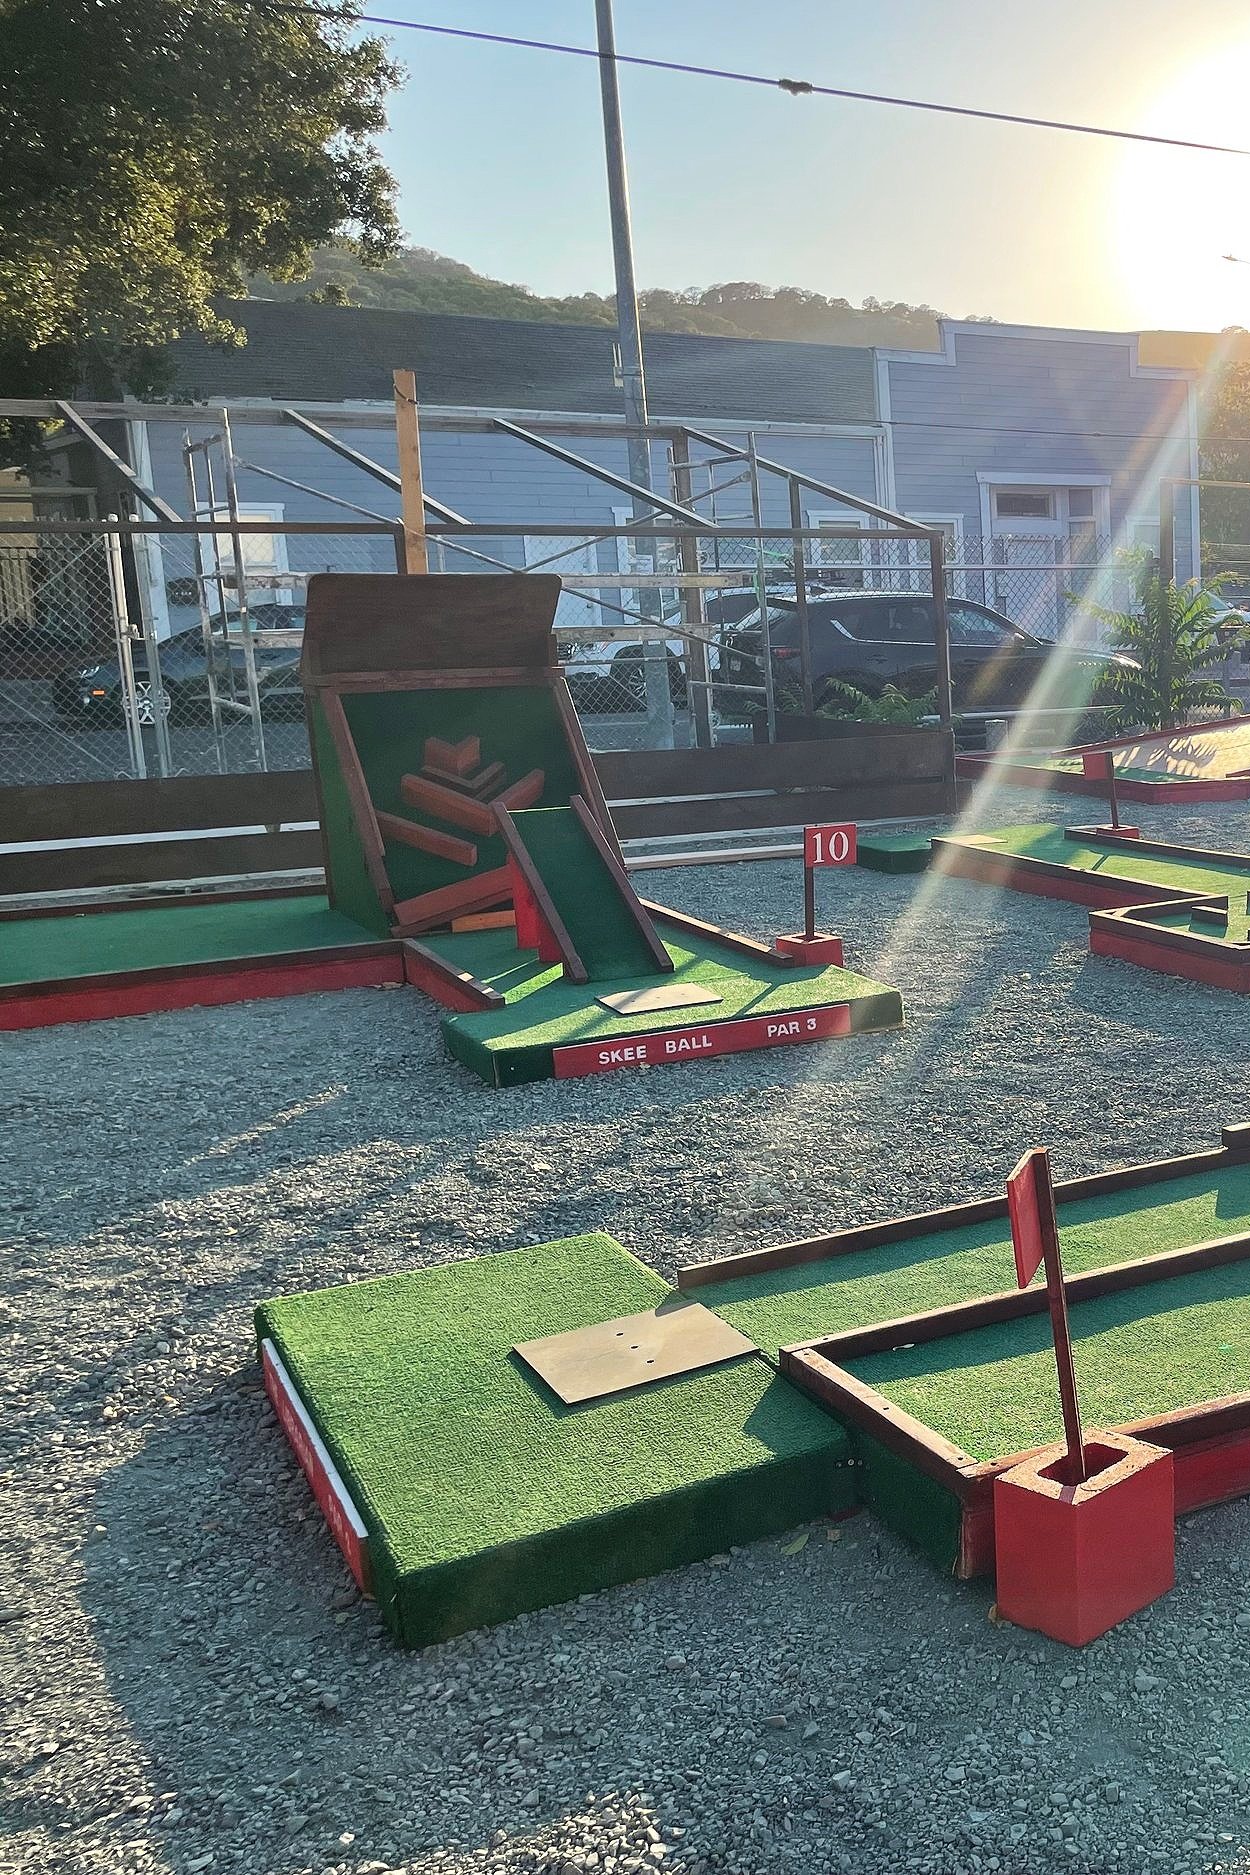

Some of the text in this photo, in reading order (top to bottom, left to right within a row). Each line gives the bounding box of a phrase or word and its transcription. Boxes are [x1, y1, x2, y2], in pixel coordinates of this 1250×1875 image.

[812, 831, 849, 864] 10
[598, 1017, 817, 1065] SKEE BALL PAR 3
